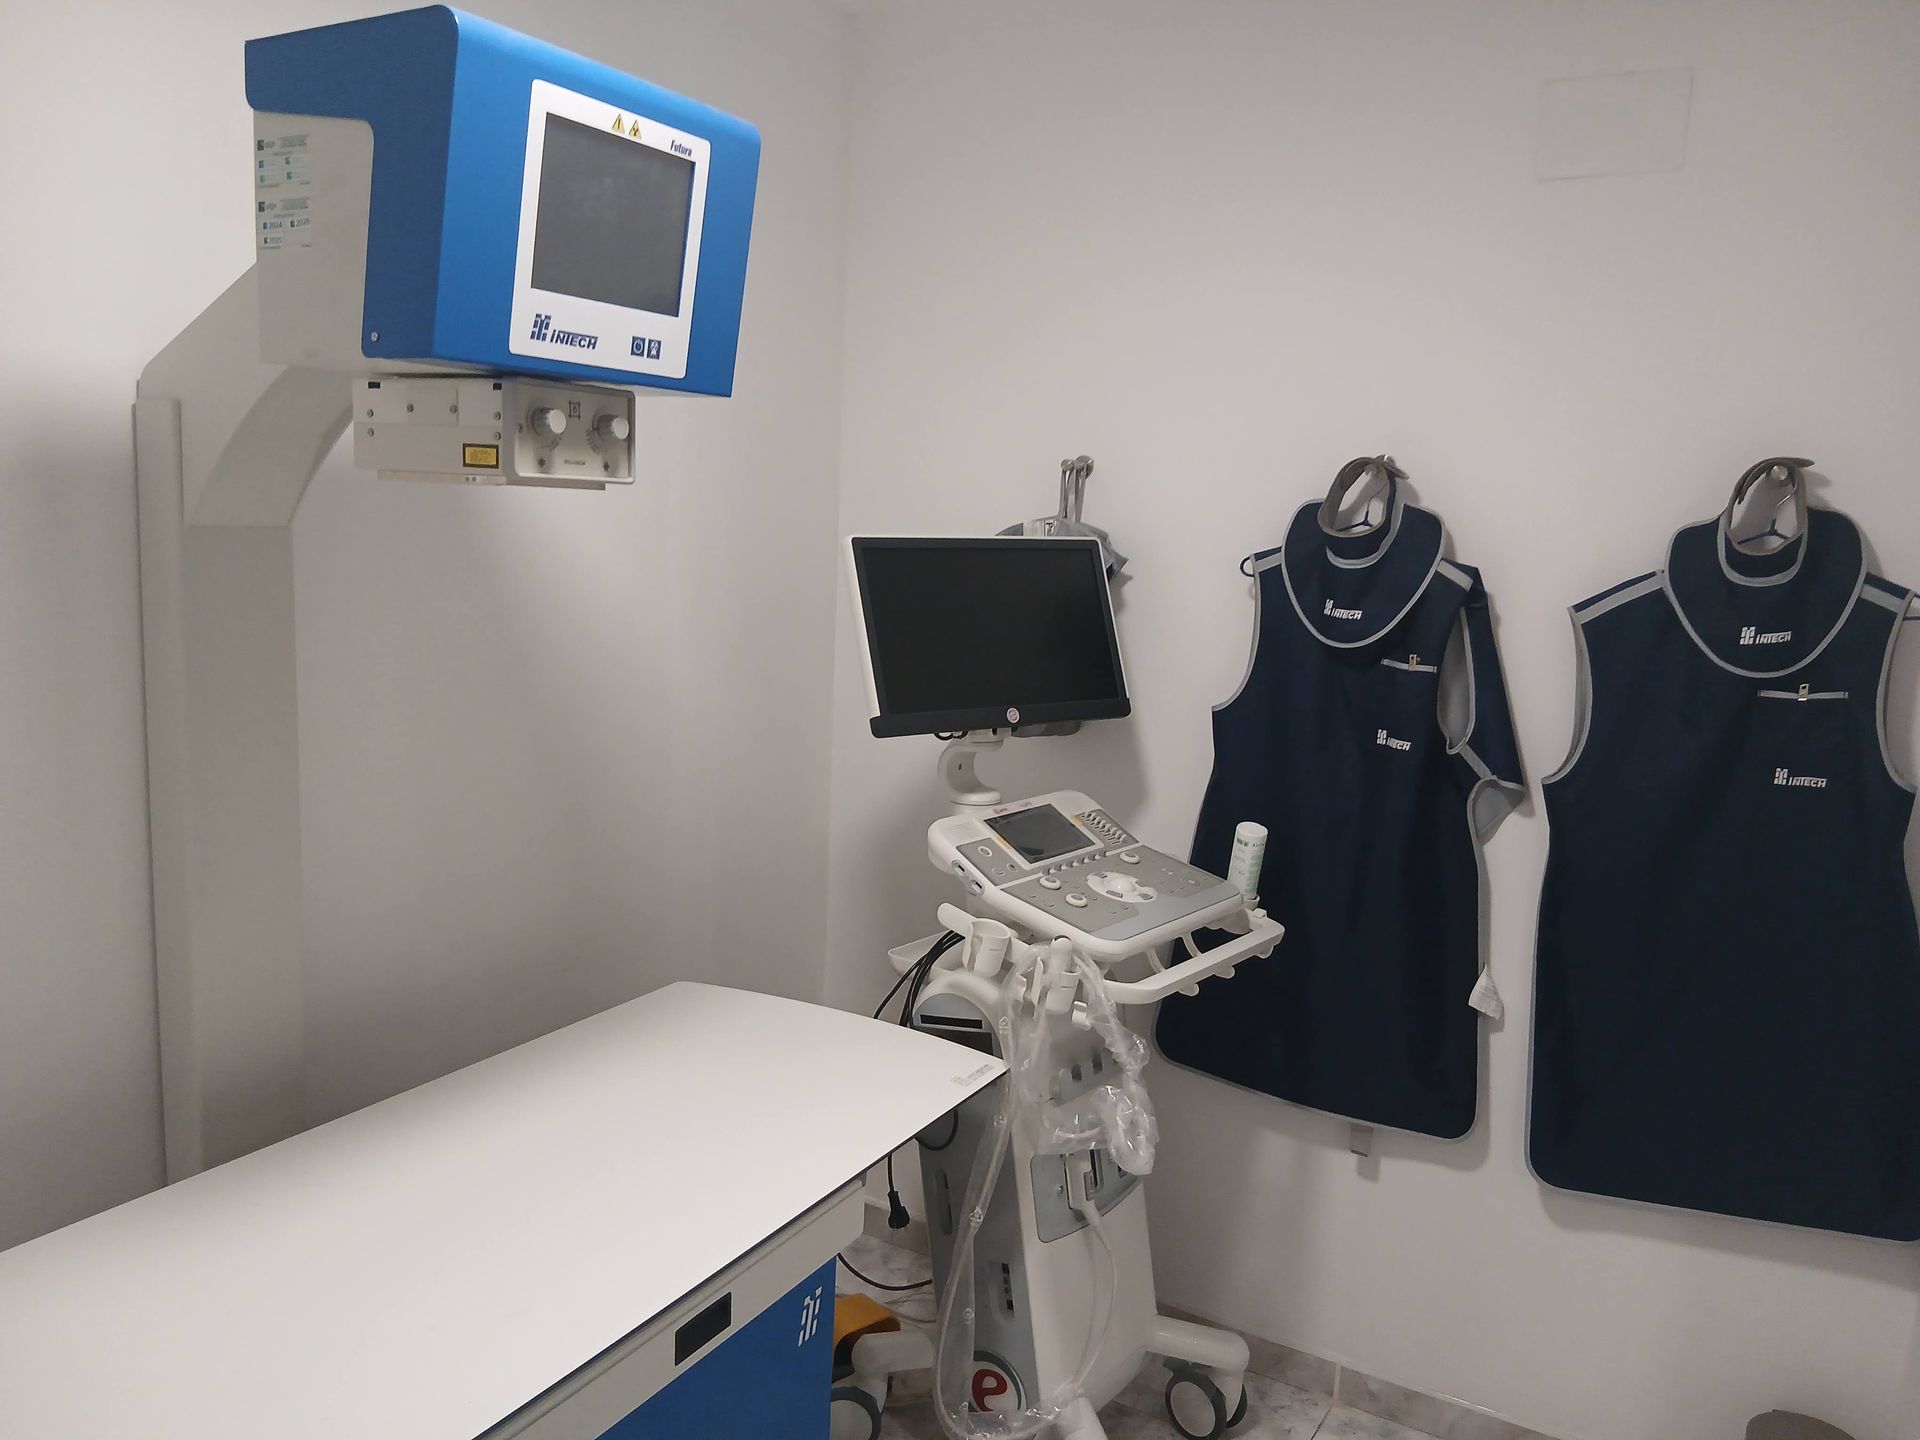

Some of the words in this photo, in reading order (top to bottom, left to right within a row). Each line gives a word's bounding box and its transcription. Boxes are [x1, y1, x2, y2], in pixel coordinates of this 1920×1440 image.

[670, 139, 692, 156] Futura
[550, 329, 598, 350] INTECH
[1755, 630, 1792, 645] INTECH
[1787, 776, 1827, 788] INTECH
